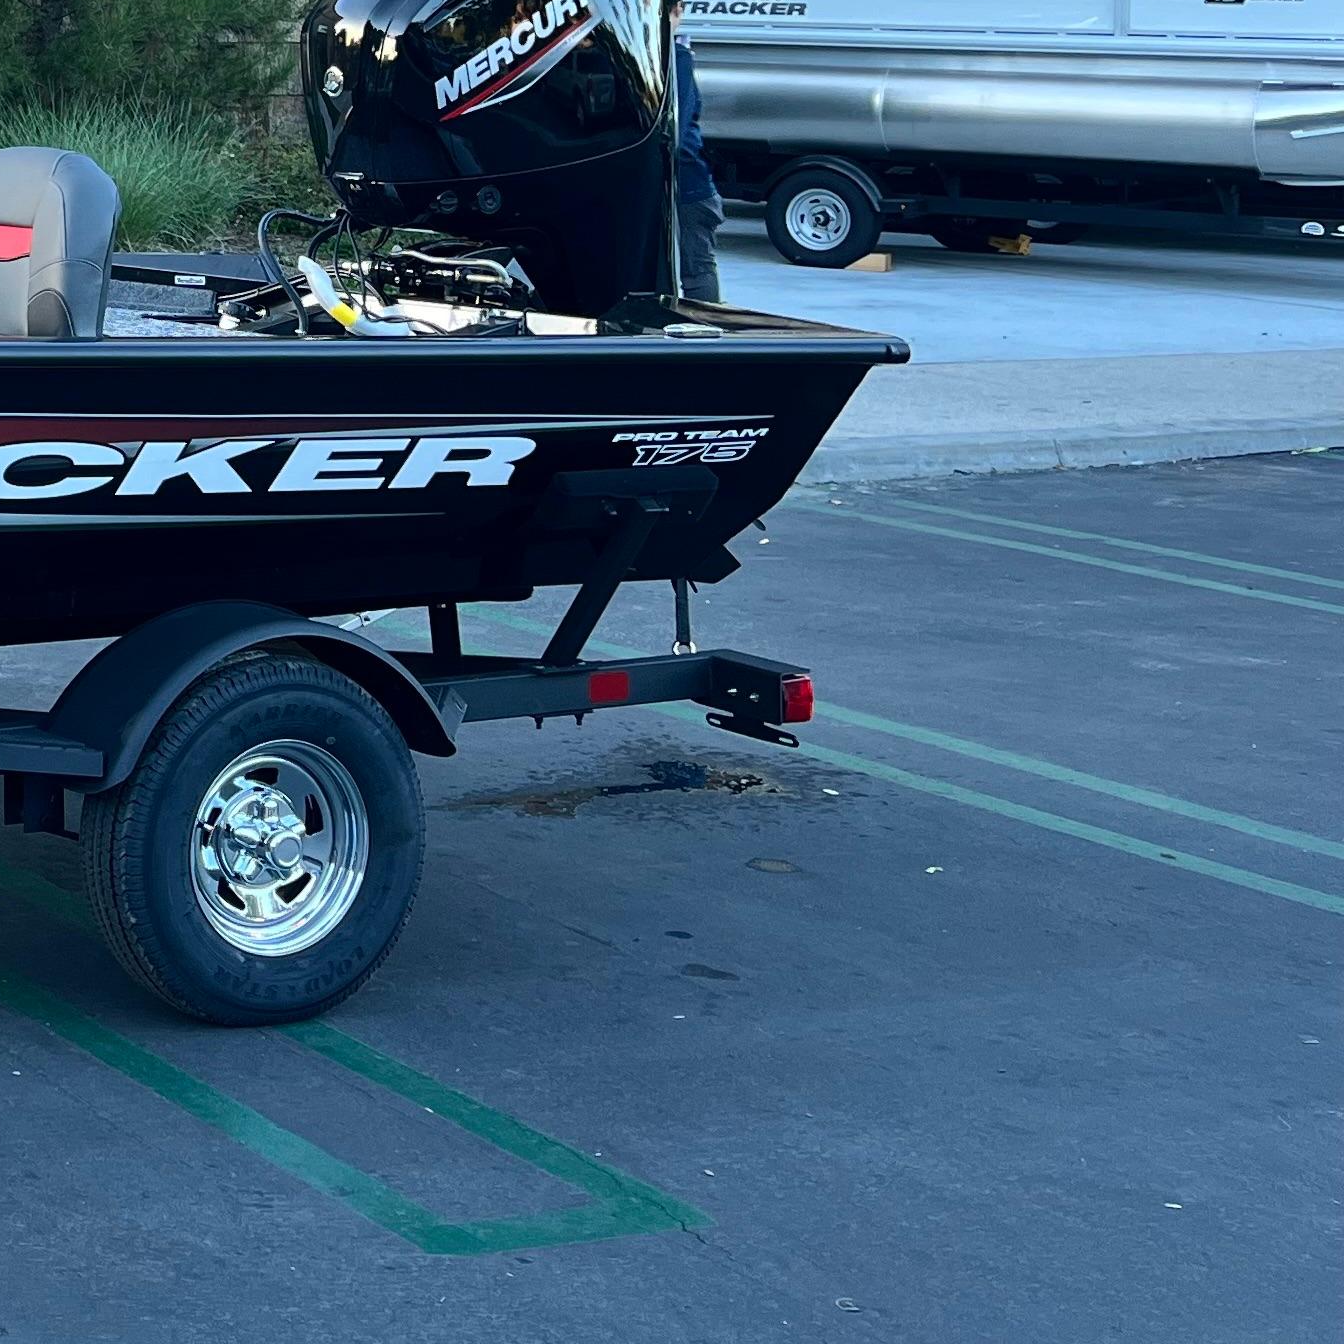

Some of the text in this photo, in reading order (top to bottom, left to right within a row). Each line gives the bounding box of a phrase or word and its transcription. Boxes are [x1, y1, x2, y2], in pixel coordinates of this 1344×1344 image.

[612, 428, 770, 443] PRO TEAM
[632, 440, 757, 466] 175
